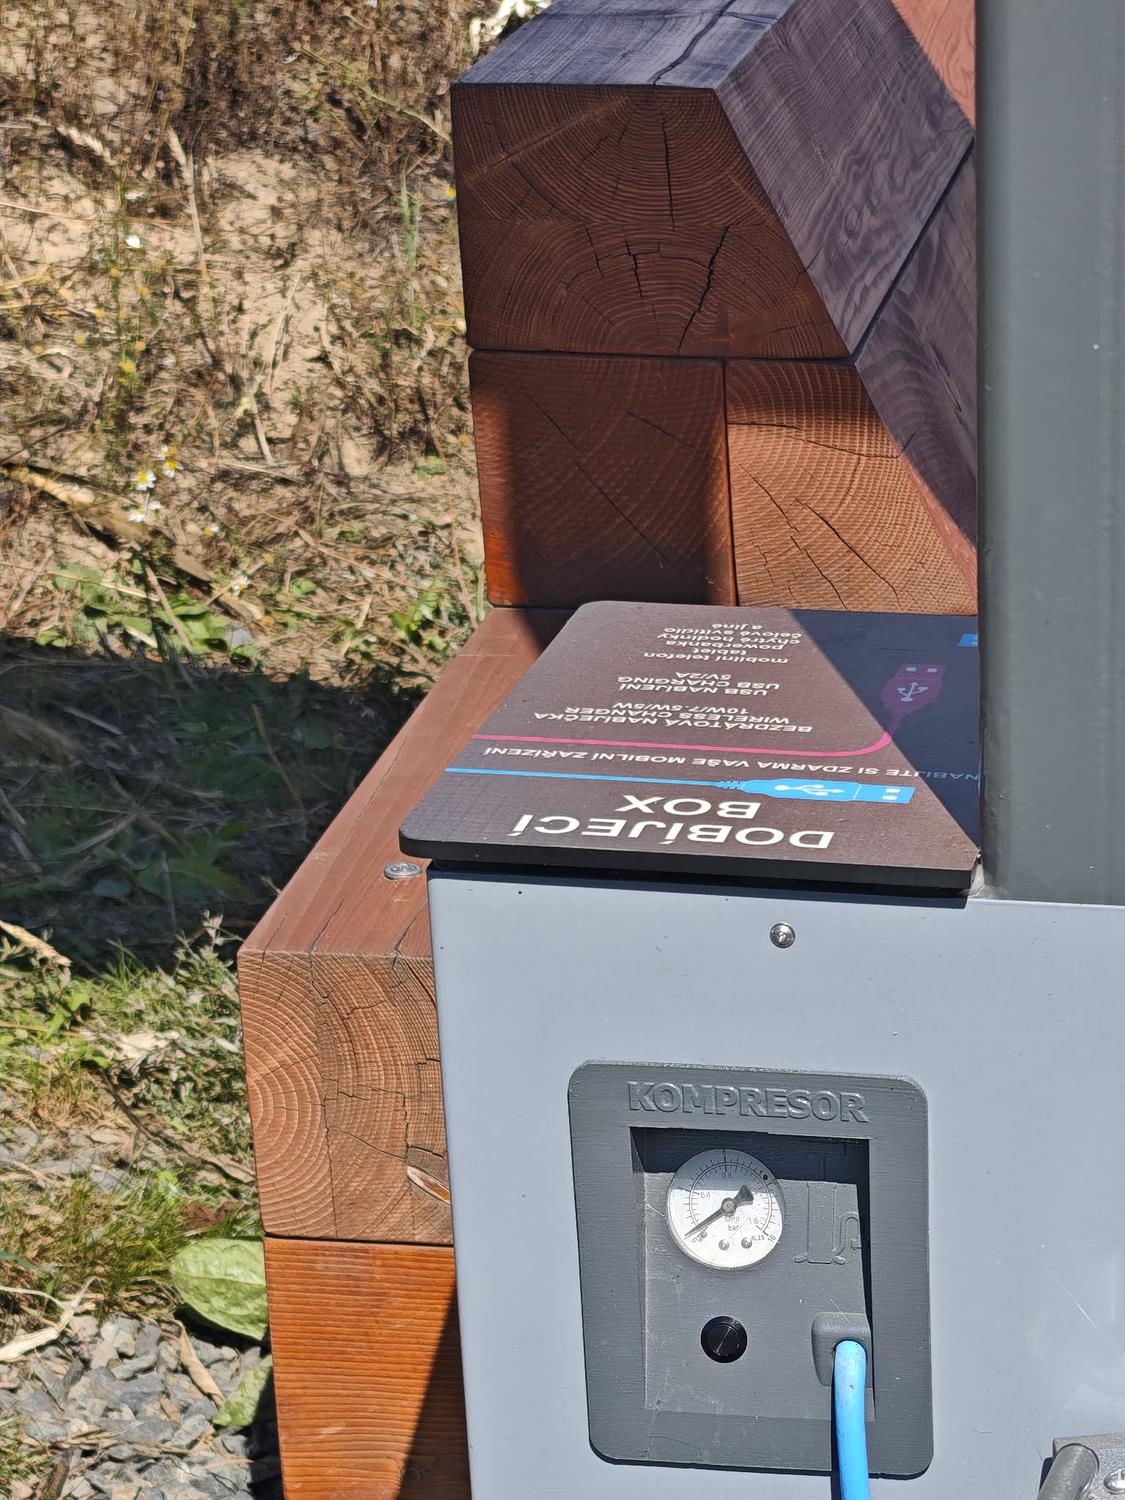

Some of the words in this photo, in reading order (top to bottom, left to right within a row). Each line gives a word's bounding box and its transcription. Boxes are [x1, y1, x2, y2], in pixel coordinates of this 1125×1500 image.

[657, 633, 734, 642] hodinky
[666, 640, 785, 650] powerbanka
[644, 651, 710, 661] telefon
[693, 648, 747, 656] tablet
[715, 655, 789, 664] mobilní
[618, 676, 730, 688] CHARGING
[675, 672, 732, 681] 5V/2A
[619, 683, 718, 695] NABÍJENÍ
[724, 687, 768, 696] USB
[737, 681, 780, 690] USB
[565, 705, 676, 719] CHANGER
[612, 702, 749, 715] 10W/7.5W/5W
[534, 711, 658, 726] NABÍJEČKA
[679, 711, 790, 725] WIRELESS
[666, 718, 813, 733] BEZDRÁTOVÁ
[483, 747, 588, 759] ZAŘÍZENÍ
[592, 751, 686, 764] MOBILNÍ
[691, 757, 749, 768] VAŠE
[757, 761, 854, 773] ZDARMA
[858, 767, 879, 776] SI
[615, 794, 761, 819] BOX
[507, 814, 835, 849] DOBÍJECÍ
[627, 1080, 869, 1123] KOMPRESOR
